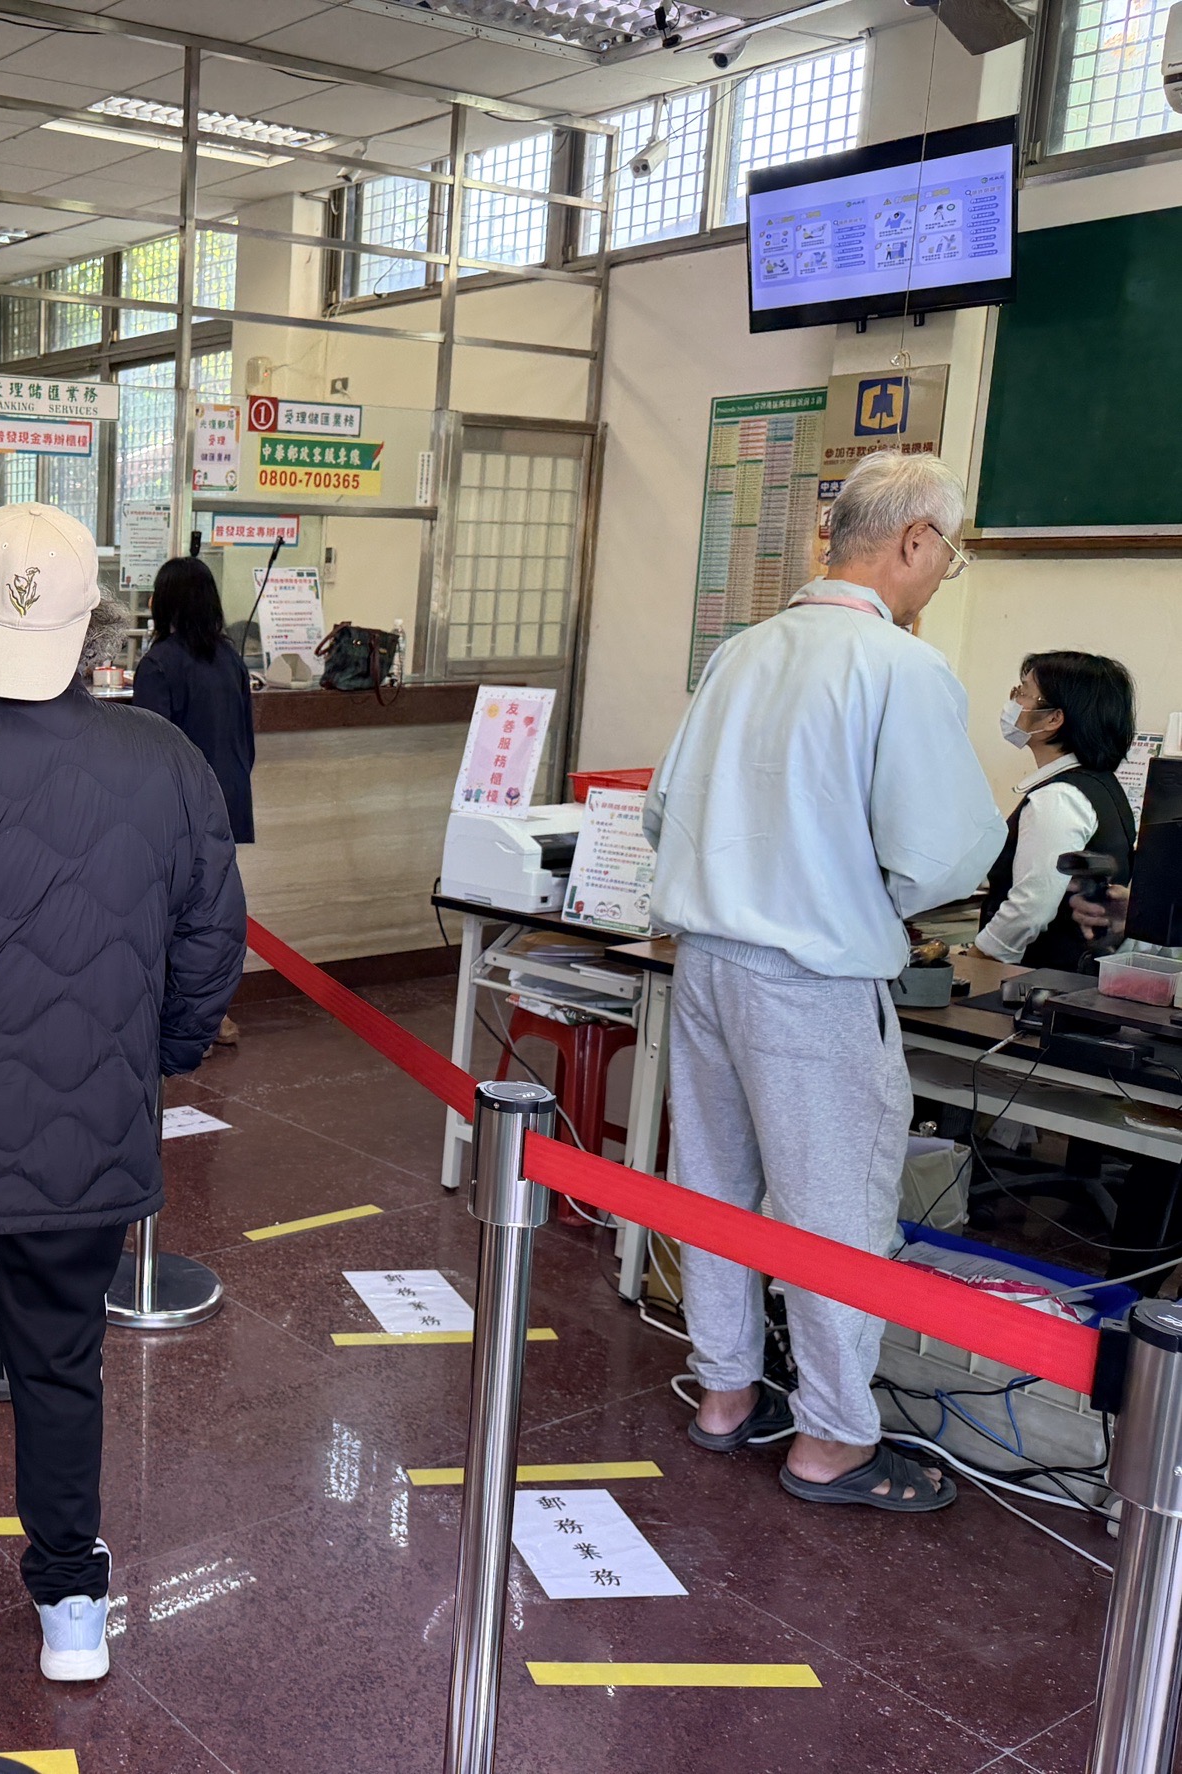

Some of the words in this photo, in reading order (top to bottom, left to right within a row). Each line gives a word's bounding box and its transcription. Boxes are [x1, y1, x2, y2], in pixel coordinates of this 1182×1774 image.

[48, 405, 98, 416] SERVICES
[258, 406, 266, 424] 1
[285, 409, 354, 428] 受理儲匯業務
[262, 443, 361, 466] 中華郵政客服專線
[259, 469, 361, 489] 0800-700365
[486, 702, 519, 804] 友善服務櫃檯
[382, 1274, 442, 1326] 郵務業務
[536, 1495, 622, 1587] 郵務業務
